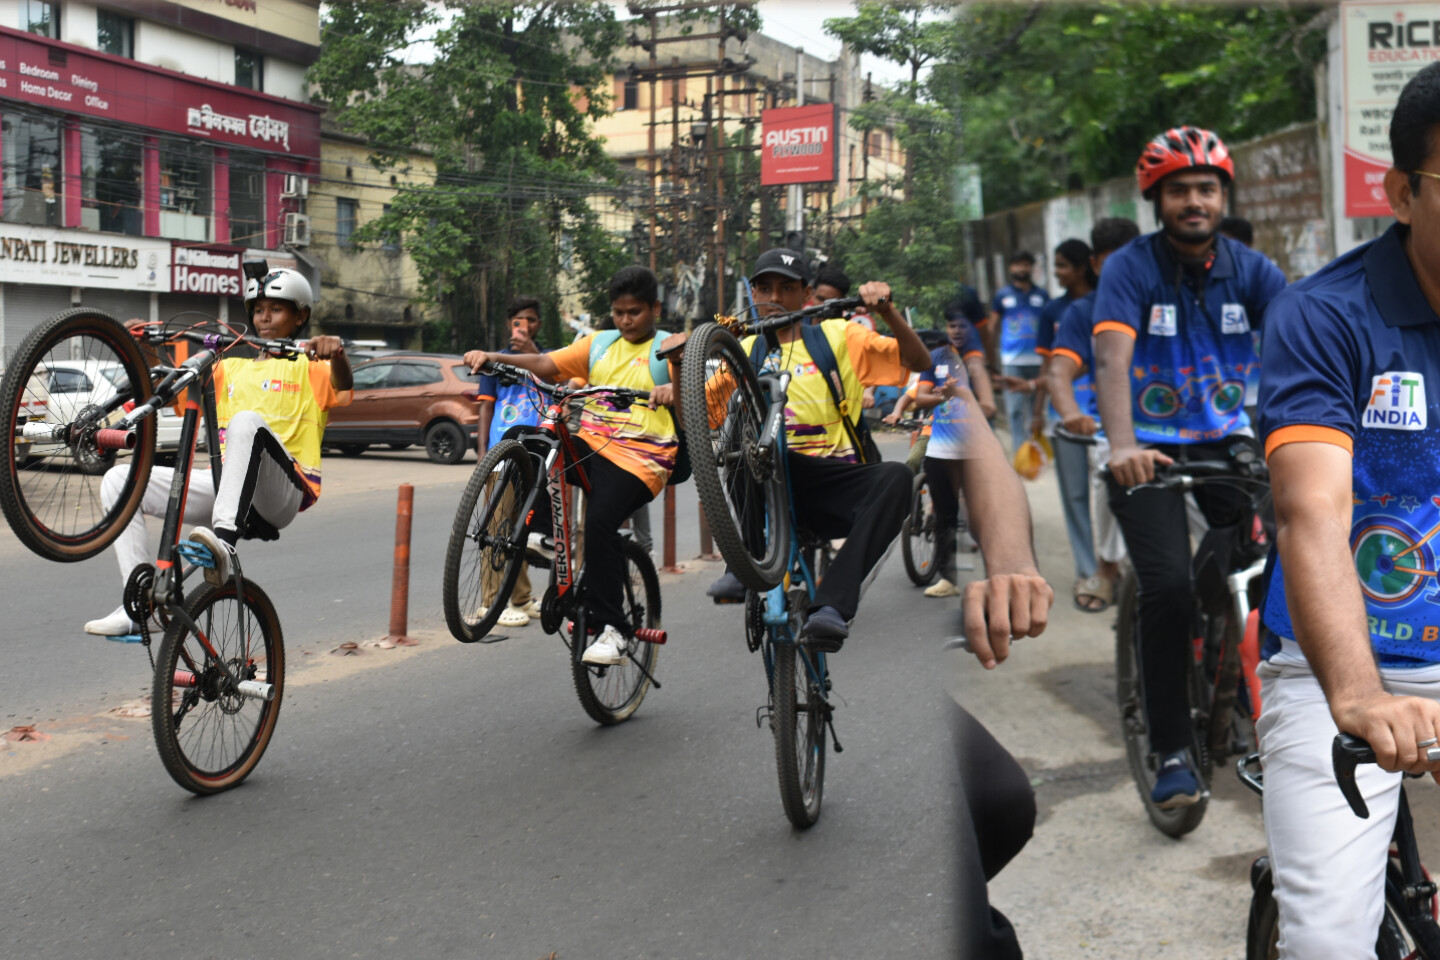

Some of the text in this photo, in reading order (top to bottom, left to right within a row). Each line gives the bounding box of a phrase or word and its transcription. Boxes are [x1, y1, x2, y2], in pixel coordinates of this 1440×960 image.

[19, 61, 60, 82] Bedroom
[70, 74, 99, 92] Dining
[20, 79, 109, 111] Home Decor Office
[765, 125, 828, 147] AUSTIN
[771, 142, 823, 158] PLYWOOD
[51, 241, 139, 269] JEWELLERS
[187, 247, 239, 270] Nilkamal
[779, 254, 796, 267] W
[174, 265, 240, 295] Homes
[1369, 375, 1420, 408] FIT
[1366, 407, 1422, 426] INDIA
[557, 551, 569, 586] HERO
[1367, 615, 1414, 642] RLD
